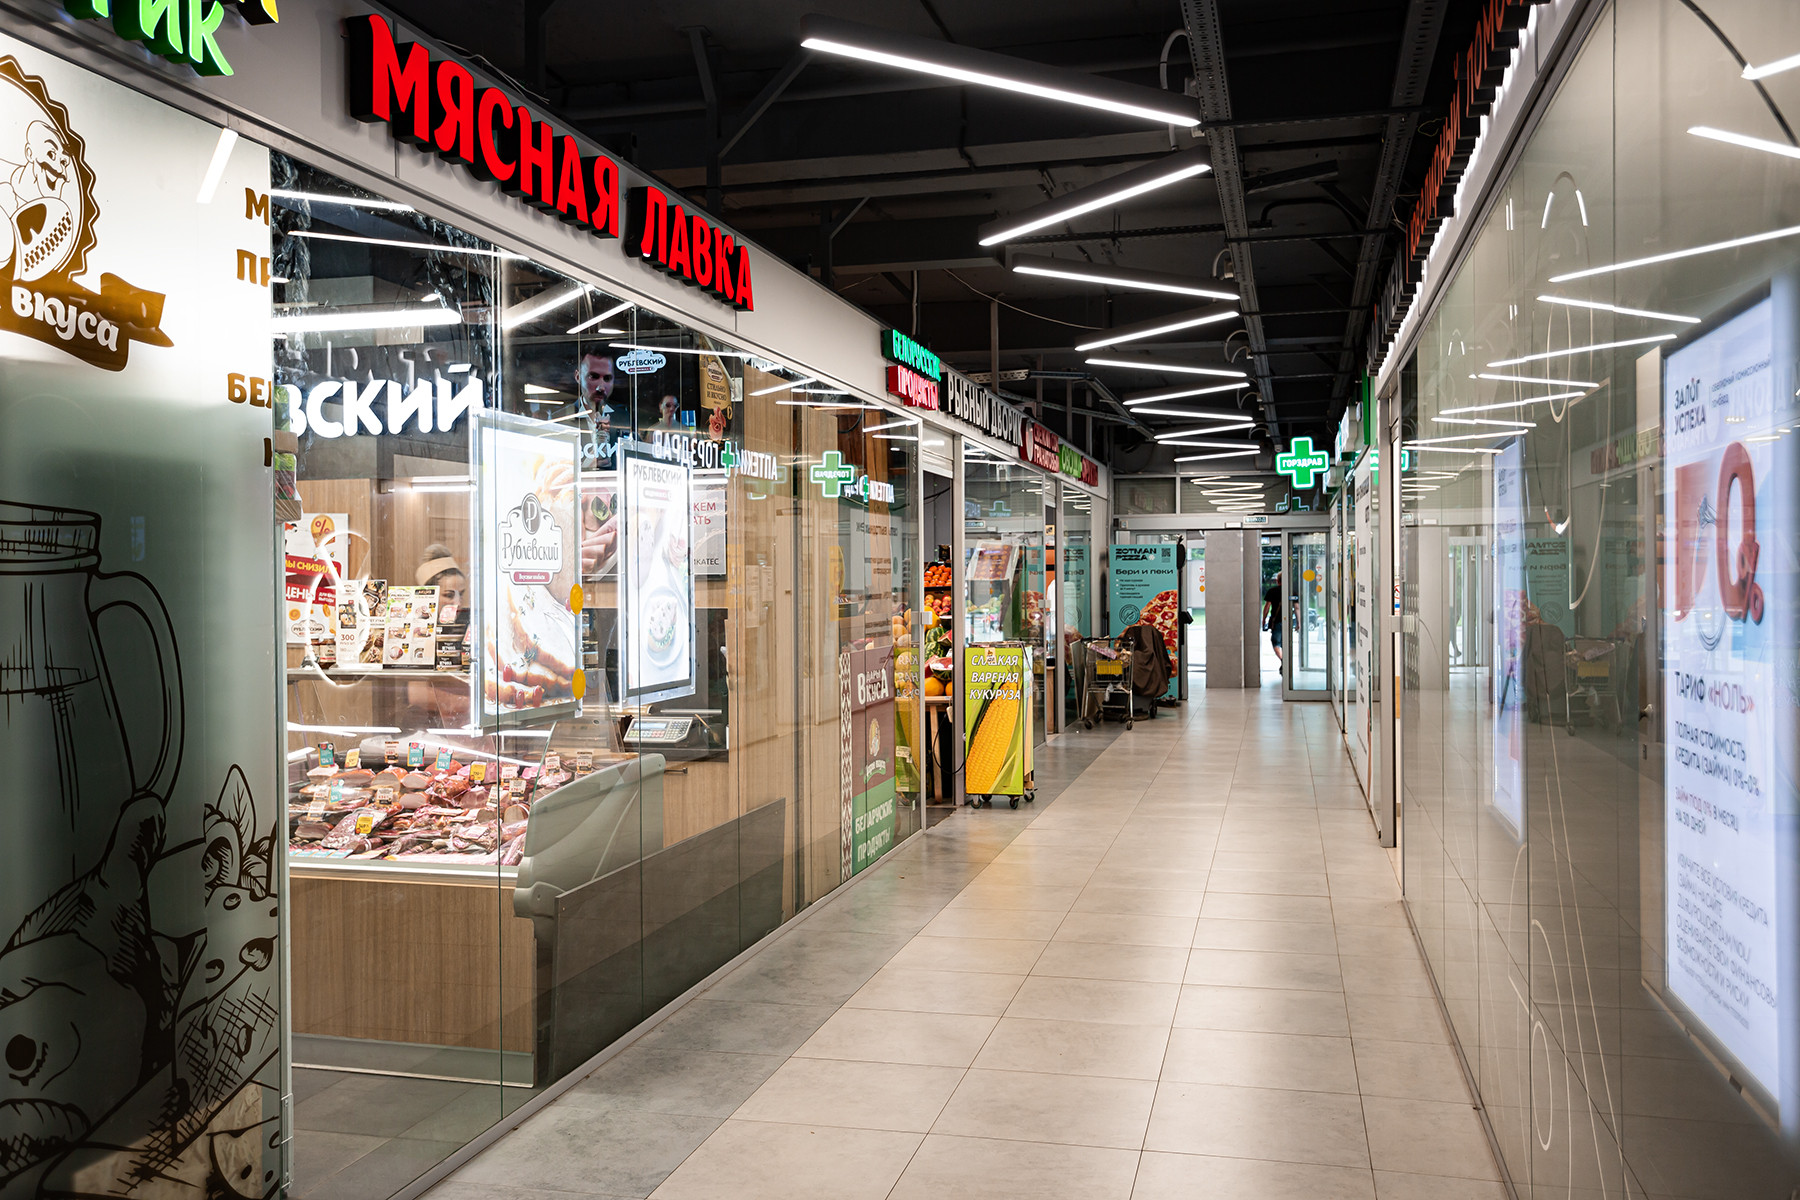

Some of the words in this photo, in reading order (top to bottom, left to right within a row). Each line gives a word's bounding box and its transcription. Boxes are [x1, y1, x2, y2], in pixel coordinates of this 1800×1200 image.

[368, 14, 619, 238] МЯСНАЯ
[641, 186, 754, 311] ЛАВКА
[1675, 378, 1701, 410] ЗАЛОГ
[1675, 404, 1706, 435] УСПЕХА
[1282, 458, 1323, 467] ГОРЗДРАВ
[502, 532, 559, 566] Рублёвский
[297, 561, 337, 574] СНИЗИЛ
[971, 672, 1019, 683] ВАРЕНАЯ
[1674, 671, 1705, 703] ТАРИФ
[969, 689, 1021, 700] КУКУРУЗА
[1700, 729, 1746, 761] СТОИМОСТЬ
